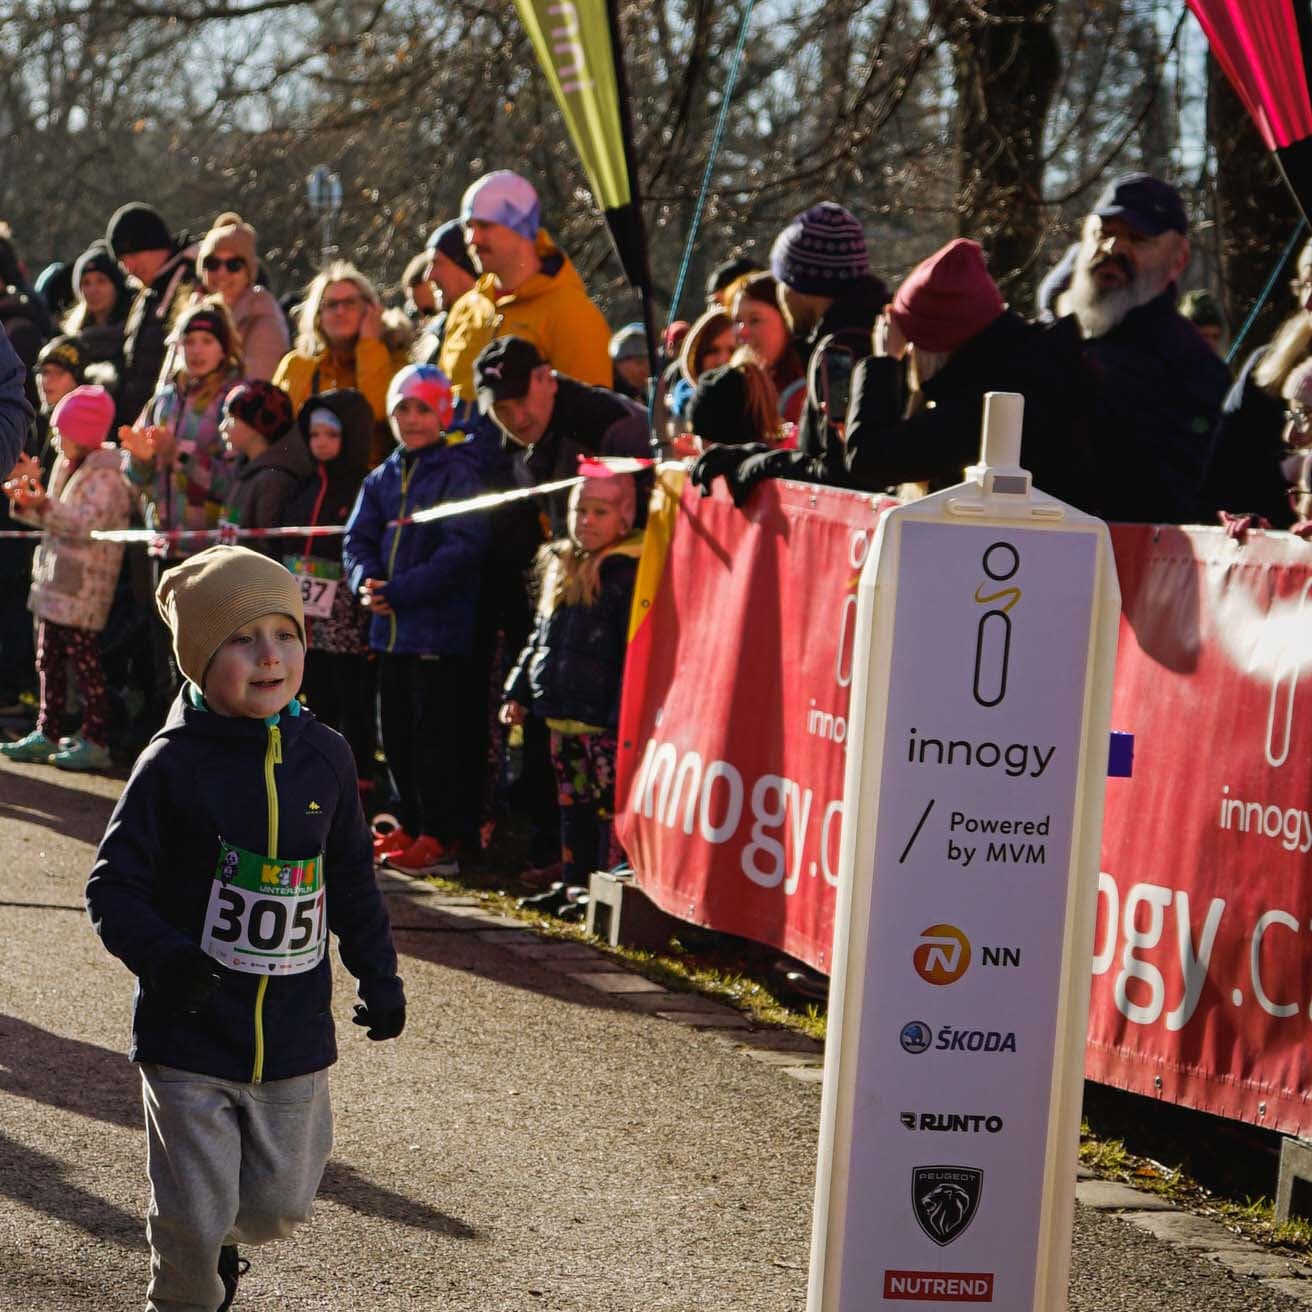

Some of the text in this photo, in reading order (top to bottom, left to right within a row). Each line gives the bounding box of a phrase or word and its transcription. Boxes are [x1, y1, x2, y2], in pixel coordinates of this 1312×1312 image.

[907, 728, 1057, 778] innogy
[633, 708, 844, 896] innogy.c
[950, 812, 1050, 836] Powered
[947, 840, 1046, 868] by MVM
[982, 947, 1021, 967] NN
[935, 1025, 1017, 1053] ŠKODA
[919, 1113, 1003, 1133] RUNTO
[918, 1172, 977, 1182] PEUGEOT
[891, 1277, 988, 1296] NUTREND
